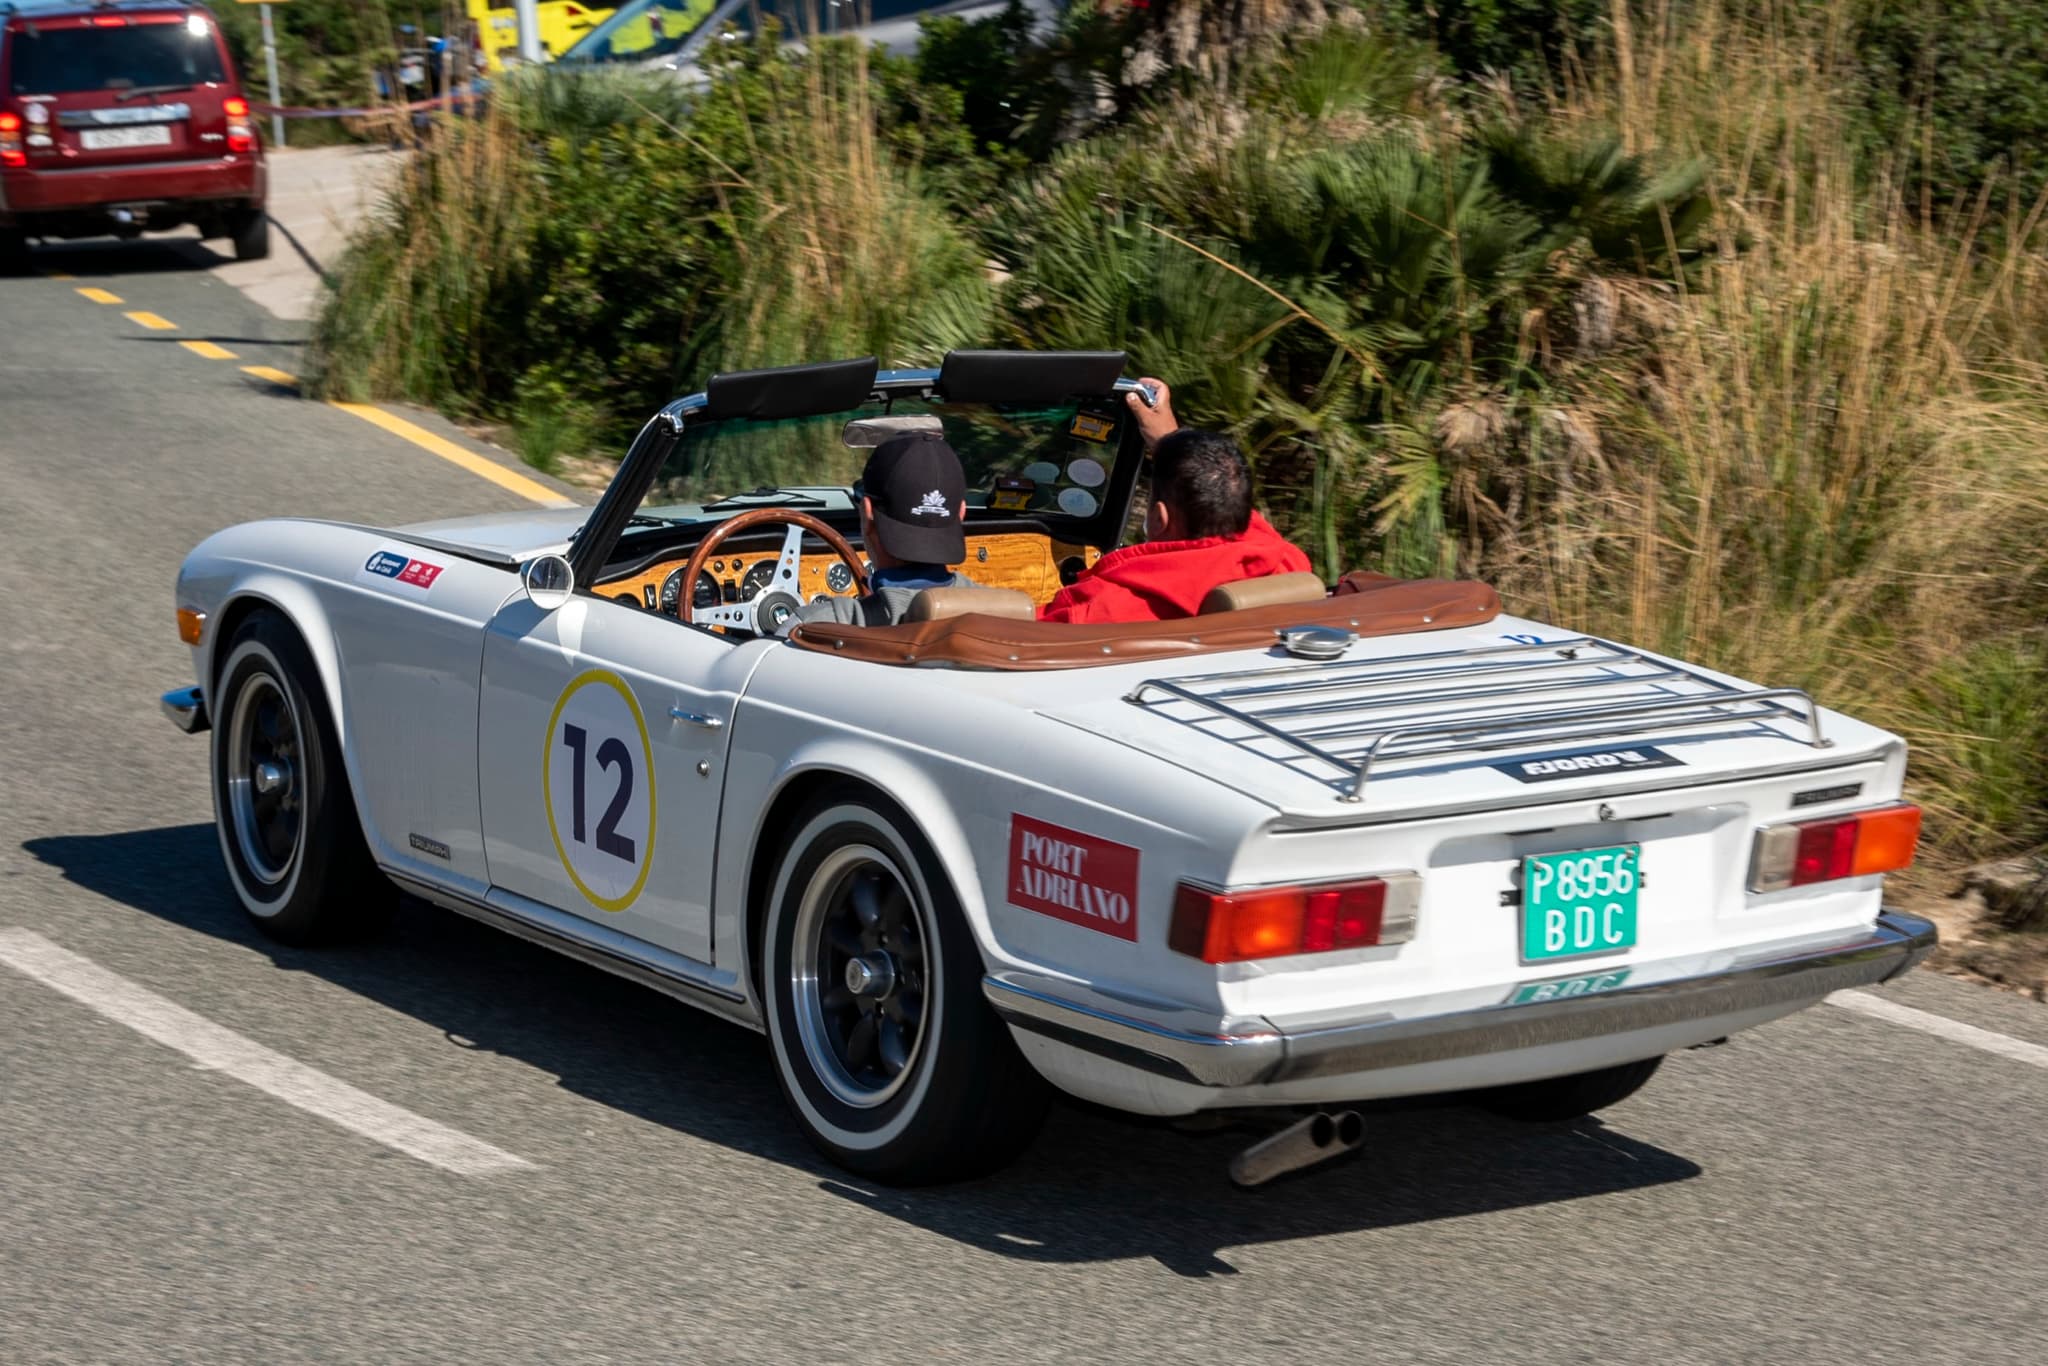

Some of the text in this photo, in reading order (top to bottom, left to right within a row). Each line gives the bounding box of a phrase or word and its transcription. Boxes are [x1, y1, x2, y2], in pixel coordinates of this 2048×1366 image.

[563, 722, 635, 864] 12
[1022, 830, 1088, 877] PORT
[1015, 864, 1130, 925] ADRIANO
[1544, 902, 1624, 952] BDC
